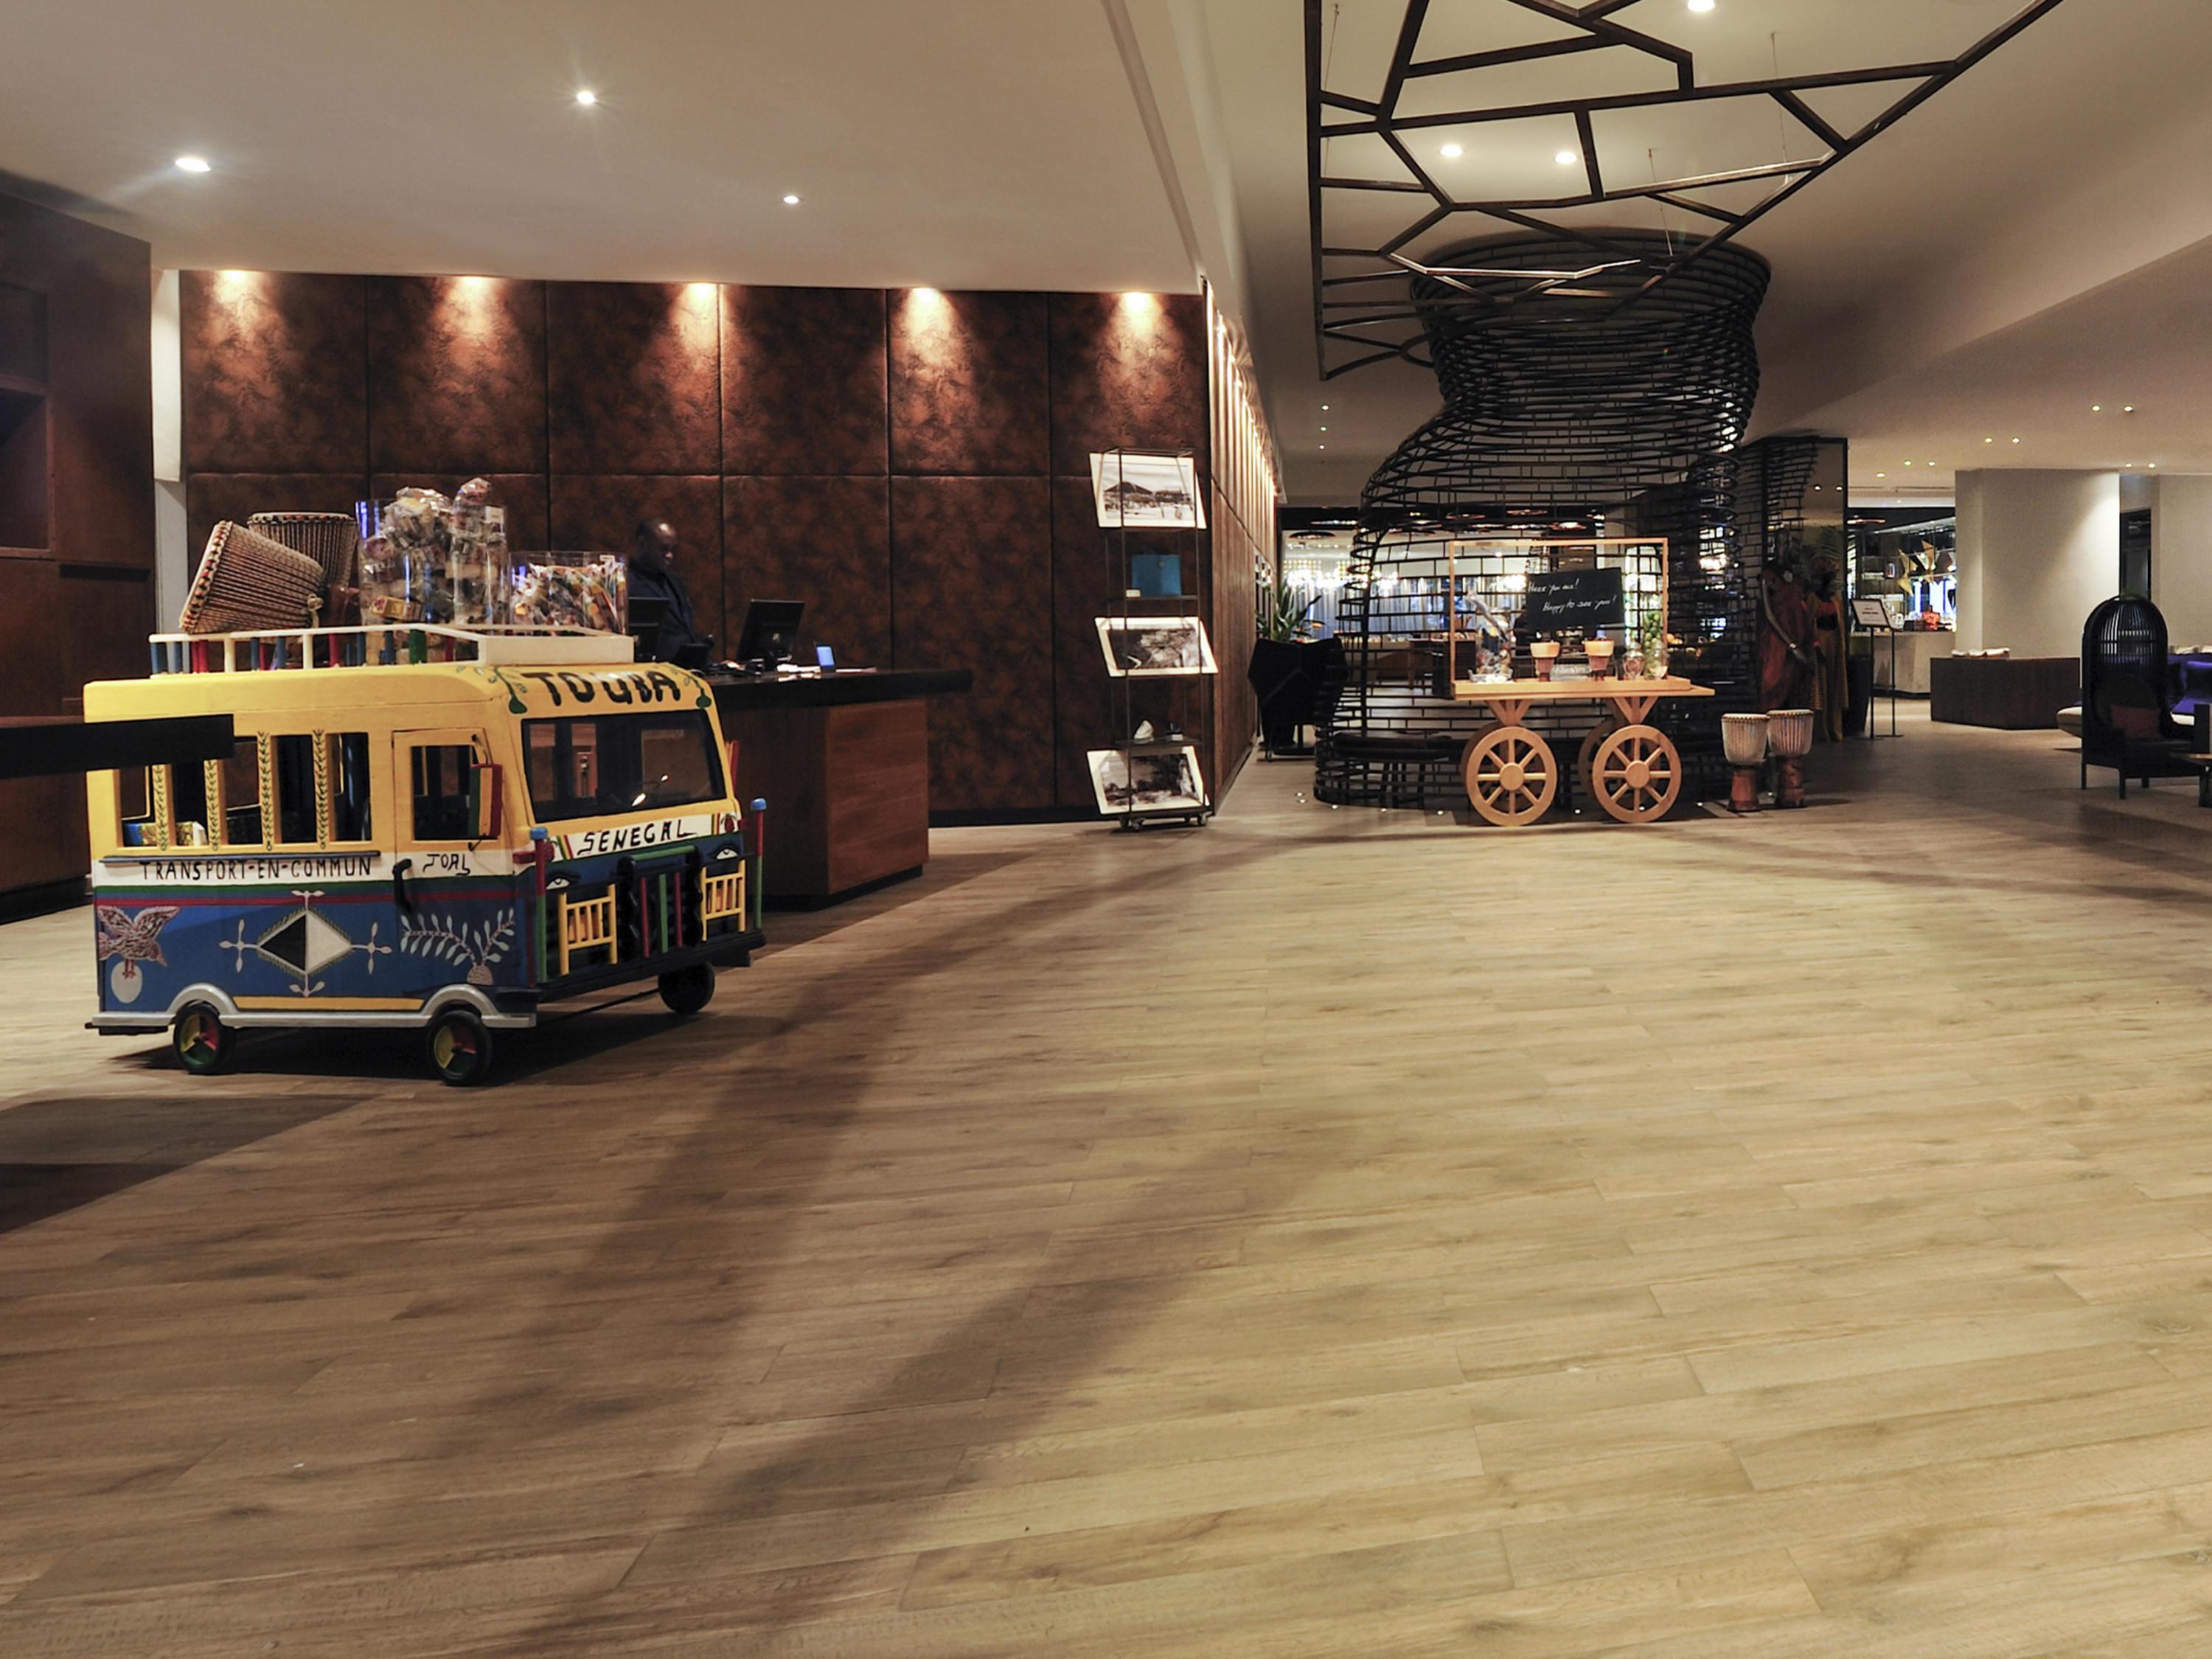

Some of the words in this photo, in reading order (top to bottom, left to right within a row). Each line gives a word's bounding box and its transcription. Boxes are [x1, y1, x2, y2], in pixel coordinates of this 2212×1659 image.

[1543, 602, 1565, 614] Happy
[1567, 599, 1575, 608] to
[1594, 595, 1616, 610] you!
[521, 671, 681, 706] TOUBA
[577, 818, 698, 855] SENEGAL
[139, 856, 372, 881] TRANSPORT-EN-COMMUN
